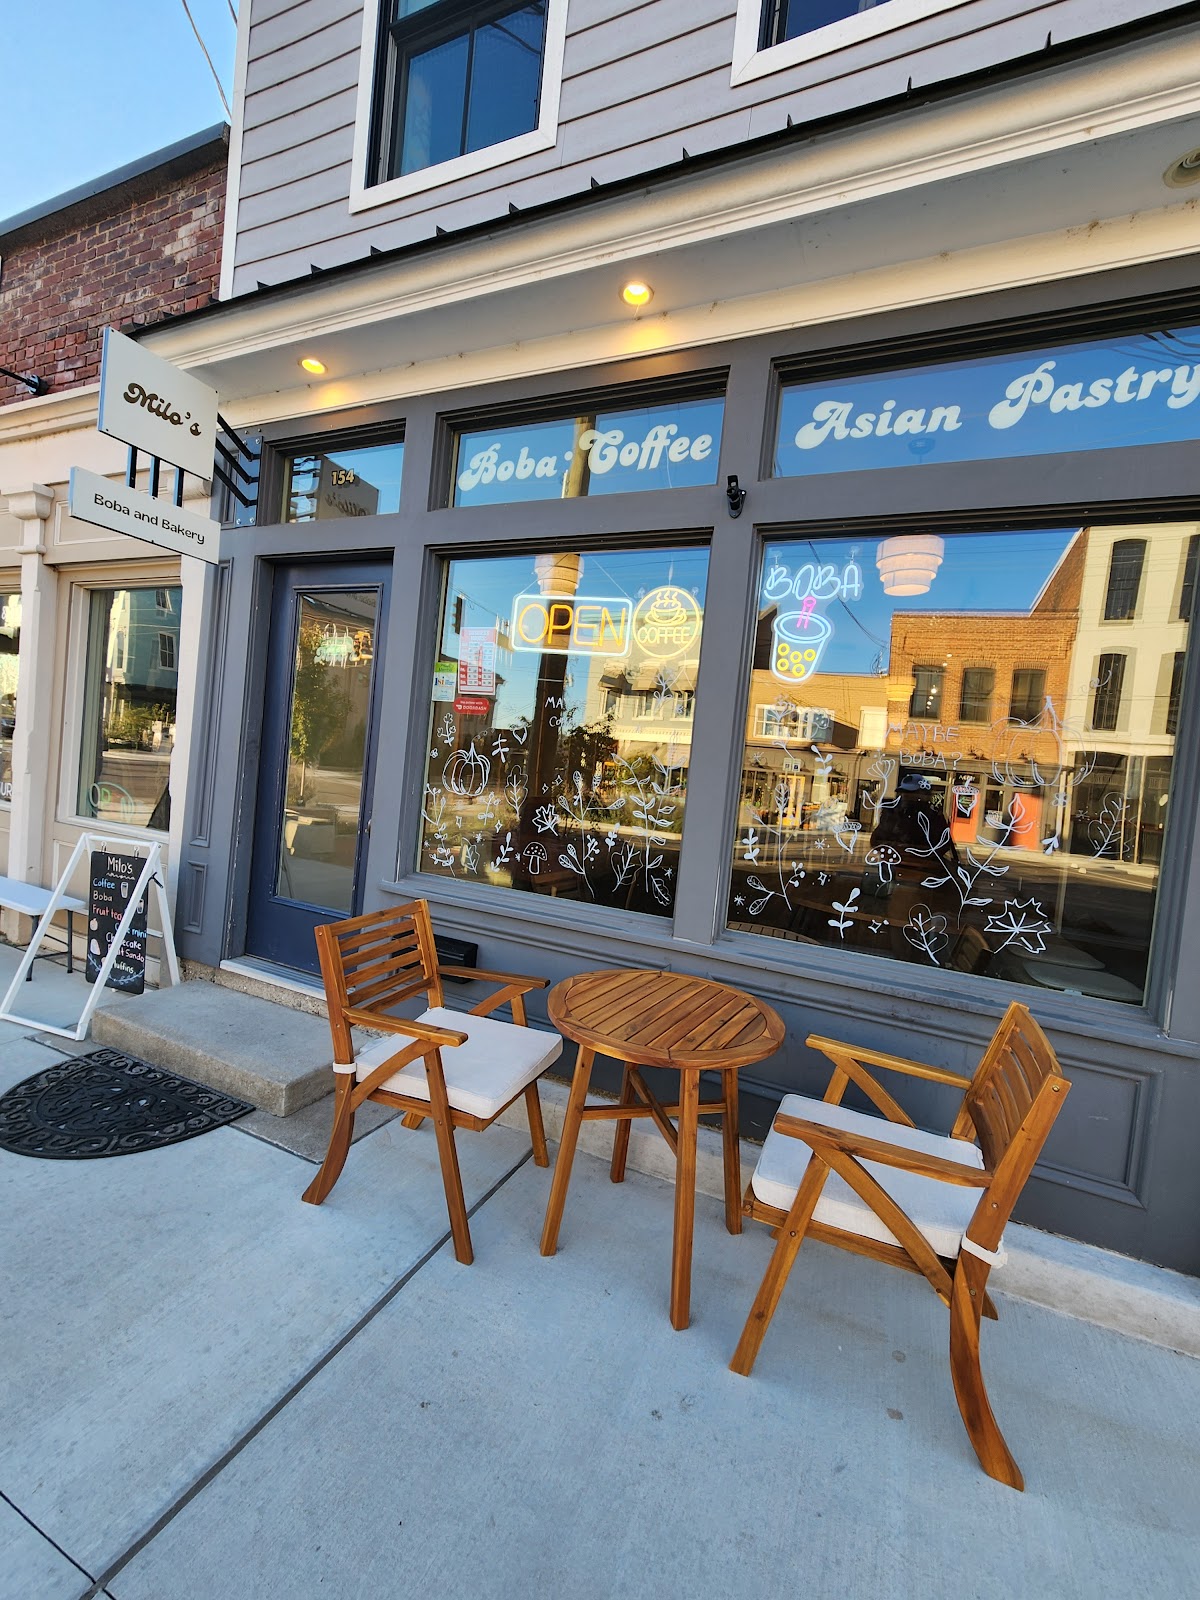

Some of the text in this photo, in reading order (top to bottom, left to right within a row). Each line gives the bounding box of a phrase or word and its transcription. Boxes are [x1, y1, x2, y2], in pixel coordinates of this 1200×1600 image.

[123, 383, 202, 436] Milo's
[795, 361, 1200, 450] Asian Pastry
[458, 423, 712, 492] Boba Coffee
[331, 469, 355, 485] 154
[94, 493, 205, 545] Boba and Bakery
[764, 564, 860, 600] BOBA
[518, 603, 626, 647] OPEN
[638, 626, 690, 645] COFFEE
[884, 722, 959, 743] MAYBE
[107, 856, 133, 874] Milo's
[93, 878, 116, 889] Coffee
[93, 890, 112, 901] Boba
[92, 904, 122, 920] Fruit tea
